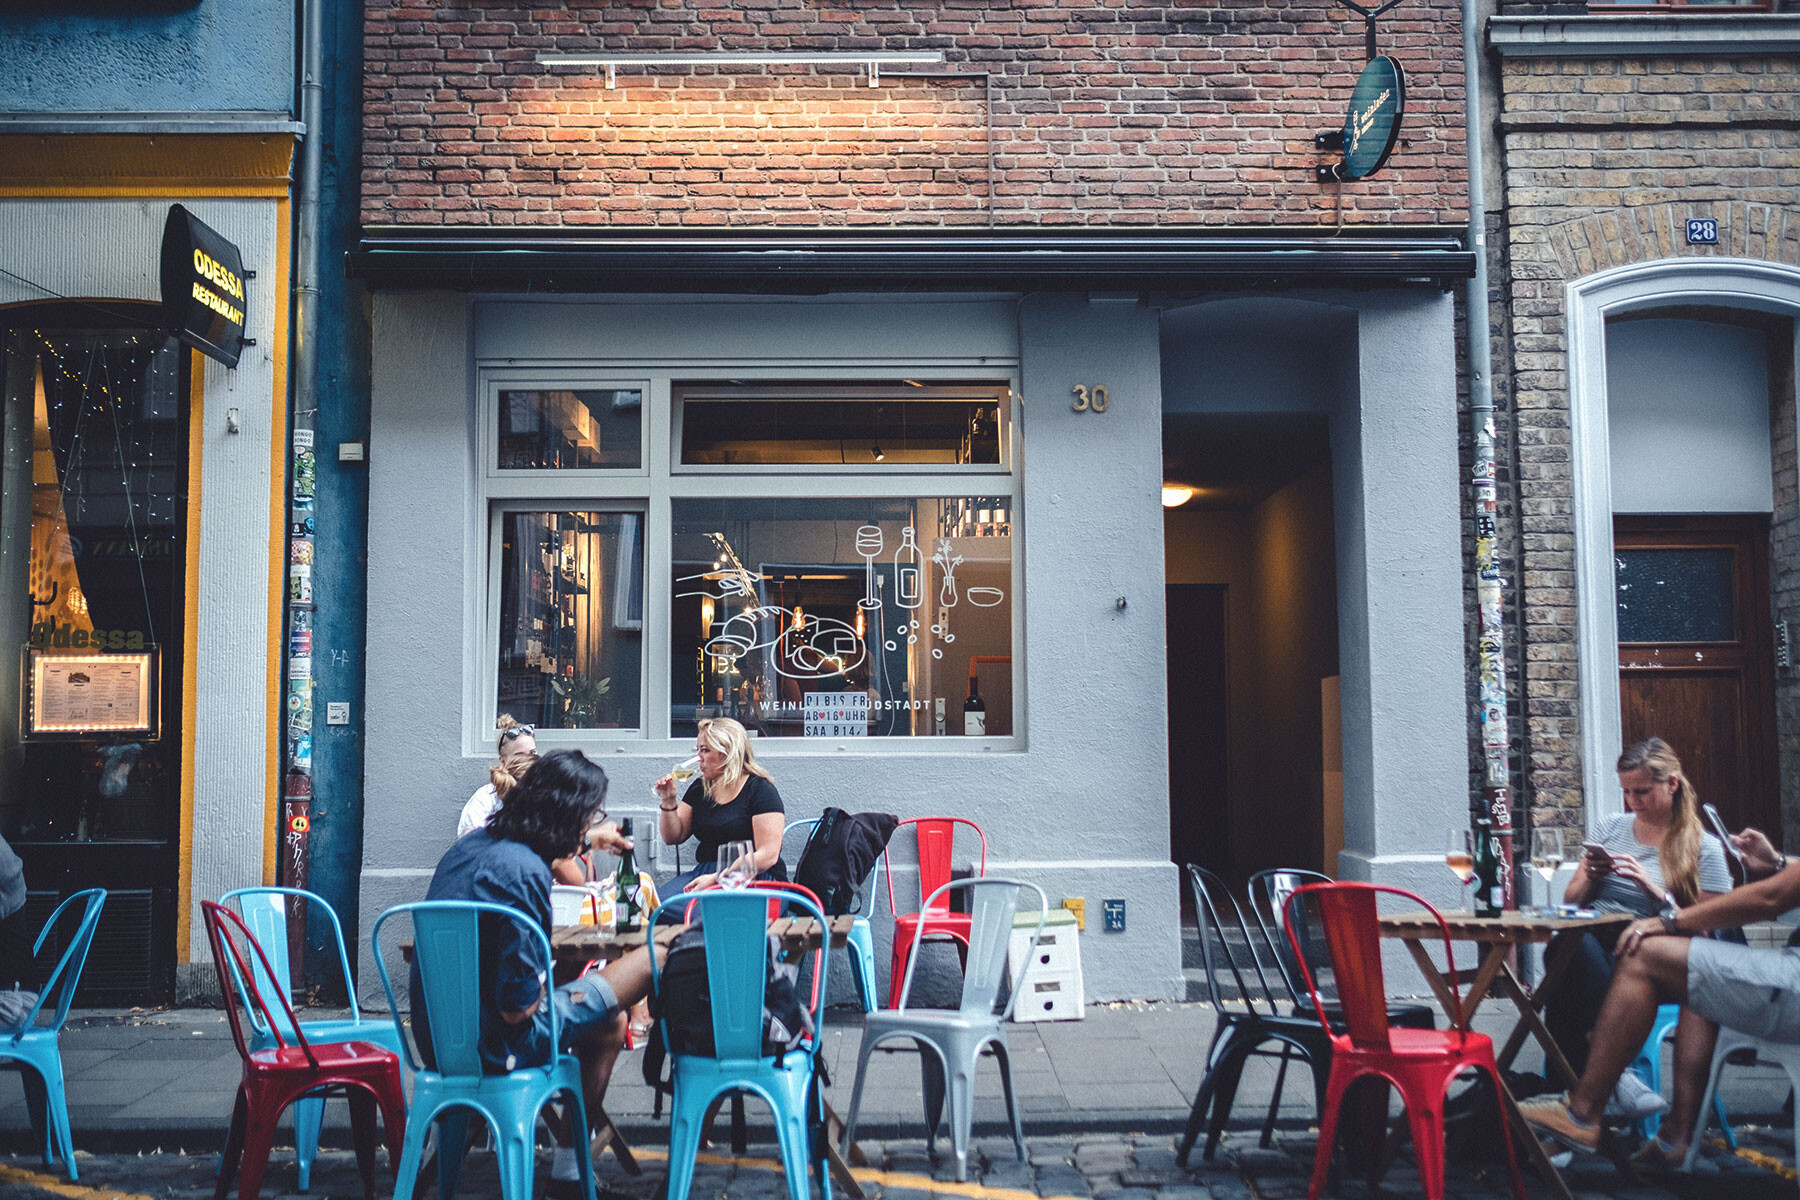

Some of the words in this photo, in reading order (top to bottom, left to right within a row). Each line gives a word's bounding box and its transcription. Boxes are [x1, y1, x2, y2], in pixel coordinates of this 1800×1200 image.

[1690, 221, 1715, 240] 28
[193, 248, 244, 302] ODESSA
[192, 281, 244, 327] RESTAURANT
[1072, 384, 1109, 411] 30
[31, 622, 144, 650] Odessa
[759, 701, 805, 711] WEINL
[866, 698, 931, 710] ÜDSTADT
[852, 695, 866, 706] FR
[805, 710, 819, 721] AB
[826, 710, 839, 721] 16
[845, 710, 866, 721] UHR
